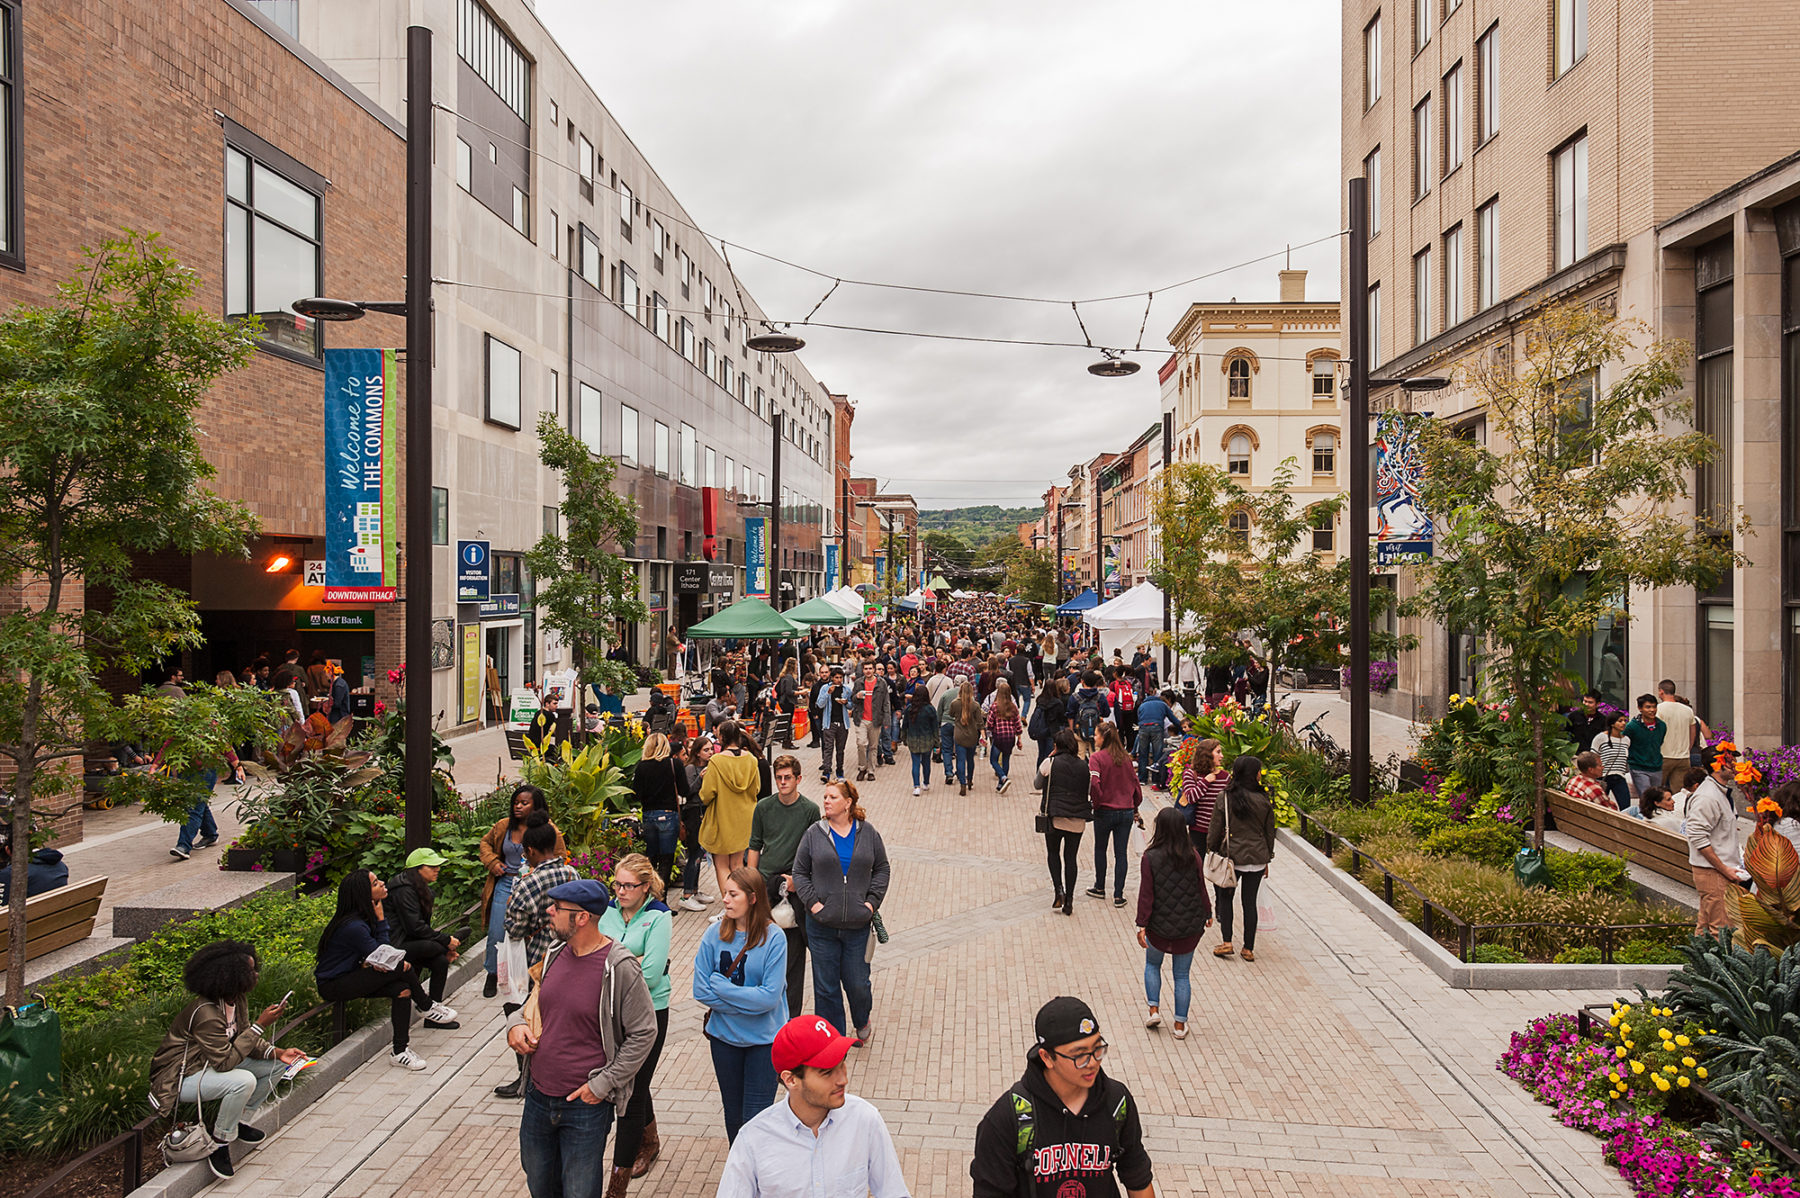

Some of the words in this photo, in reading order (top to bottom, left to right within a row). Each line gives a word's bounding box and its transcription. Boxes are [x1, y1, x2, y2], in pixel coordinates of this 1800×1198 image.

[341, 376, 361, 397] to
[365, 376, 384, 456] COMMONS
[339, 402, 361, 490] Welcome
[364, 462, 382, 491] THE
[309, 562, 322, 571] 24
[307, 573, 326, 584] AT
[327, 591, 369, 600] DOWNTOWN
[369, 591, 394, 600] ITHACA
[322, 615, 340, 624] M&T
[341, 615, 363, 624] Bank
[814, 1020, 832, 1038] P
[1033, 1143, 1111, 1176] CORNELL
